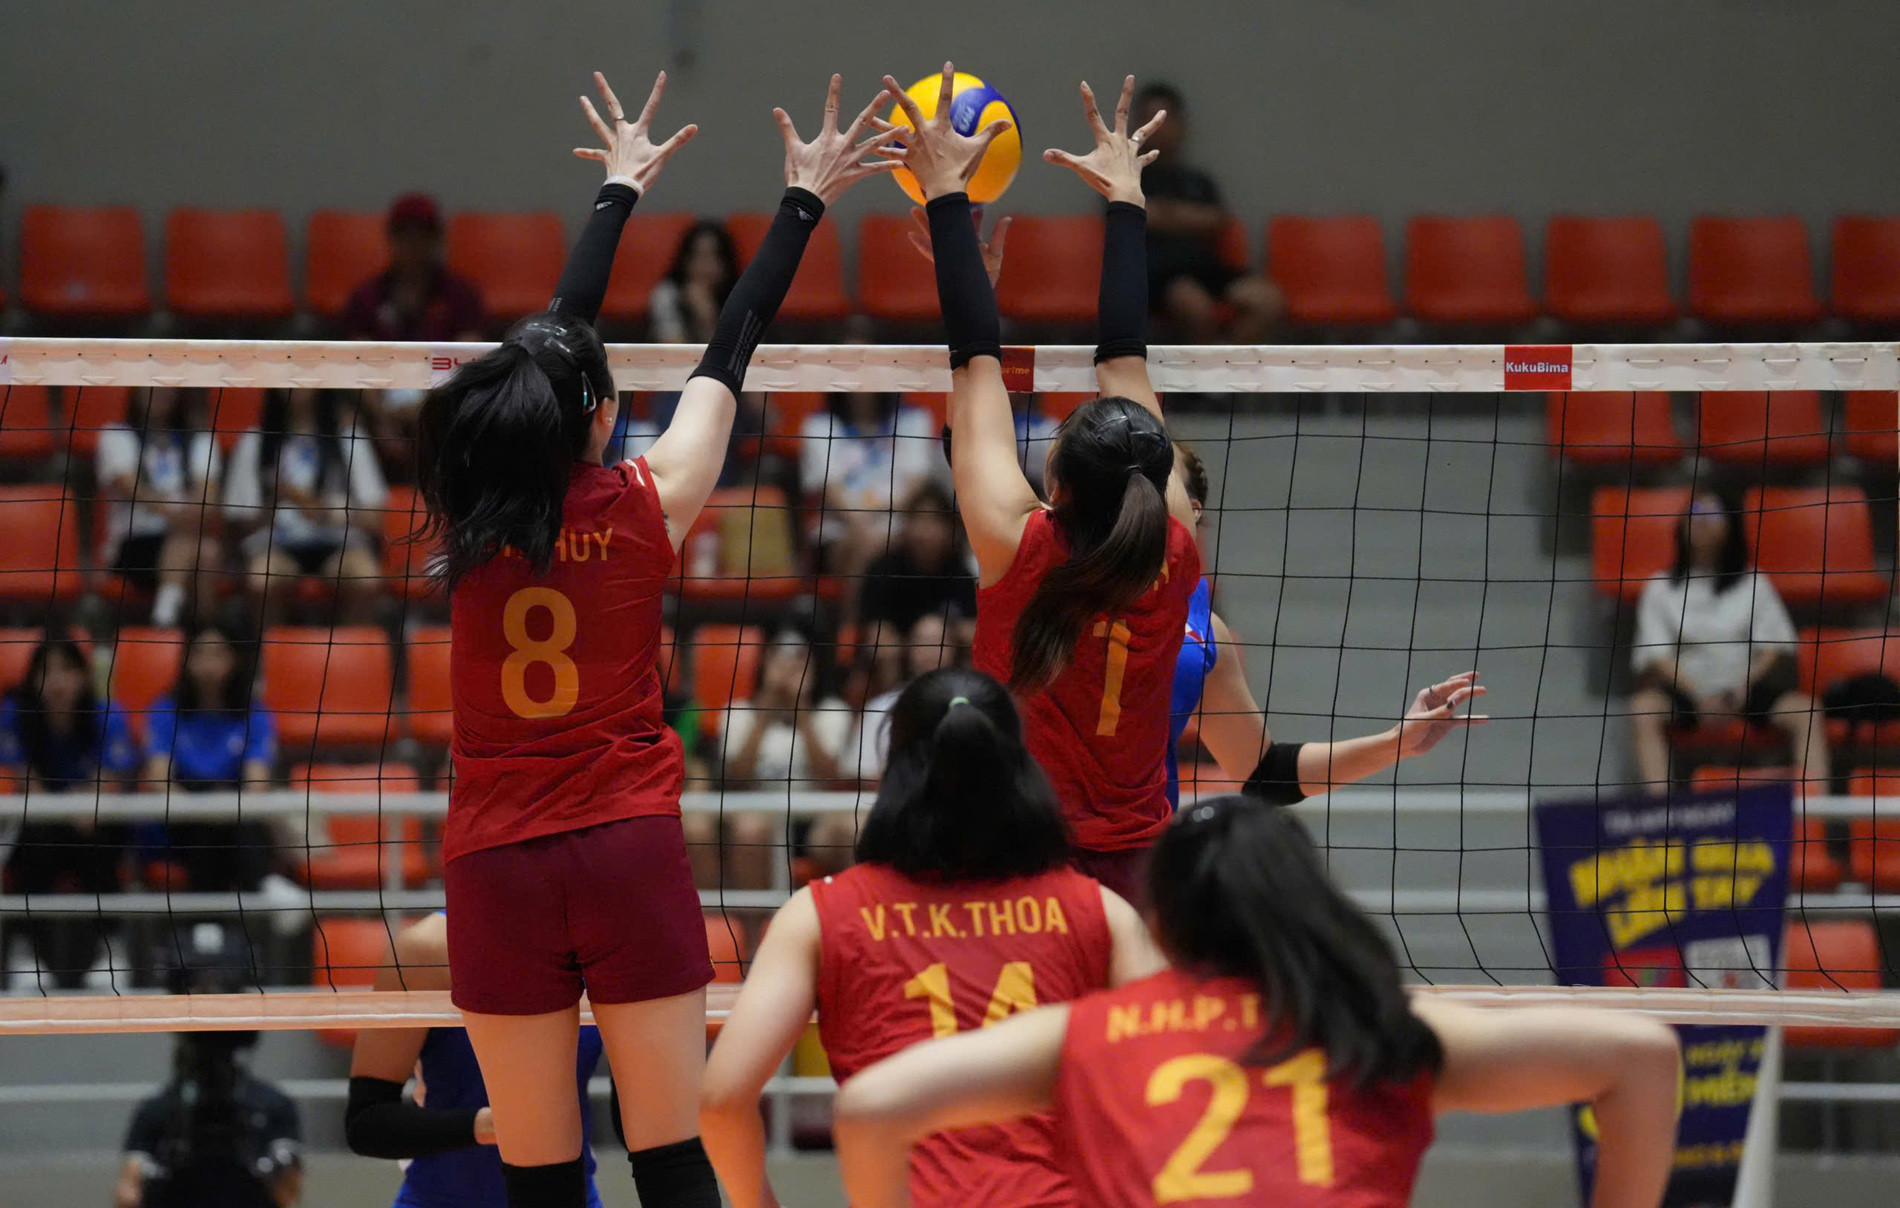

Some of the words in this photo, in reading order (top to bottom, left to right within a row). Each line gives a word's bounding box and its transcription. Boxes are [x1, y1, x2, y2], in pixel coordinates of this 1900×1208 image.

[1505, 361, 1569, 373] KukuBima
[554, 527, 613, 562] HUY
[501, 586, 580, 719] 8
[1092, 619, 1131, 736] 1
[860, 896, 1068, 941] V.T.K.THOA
[1146, 1049, 1334, 1204] 21
